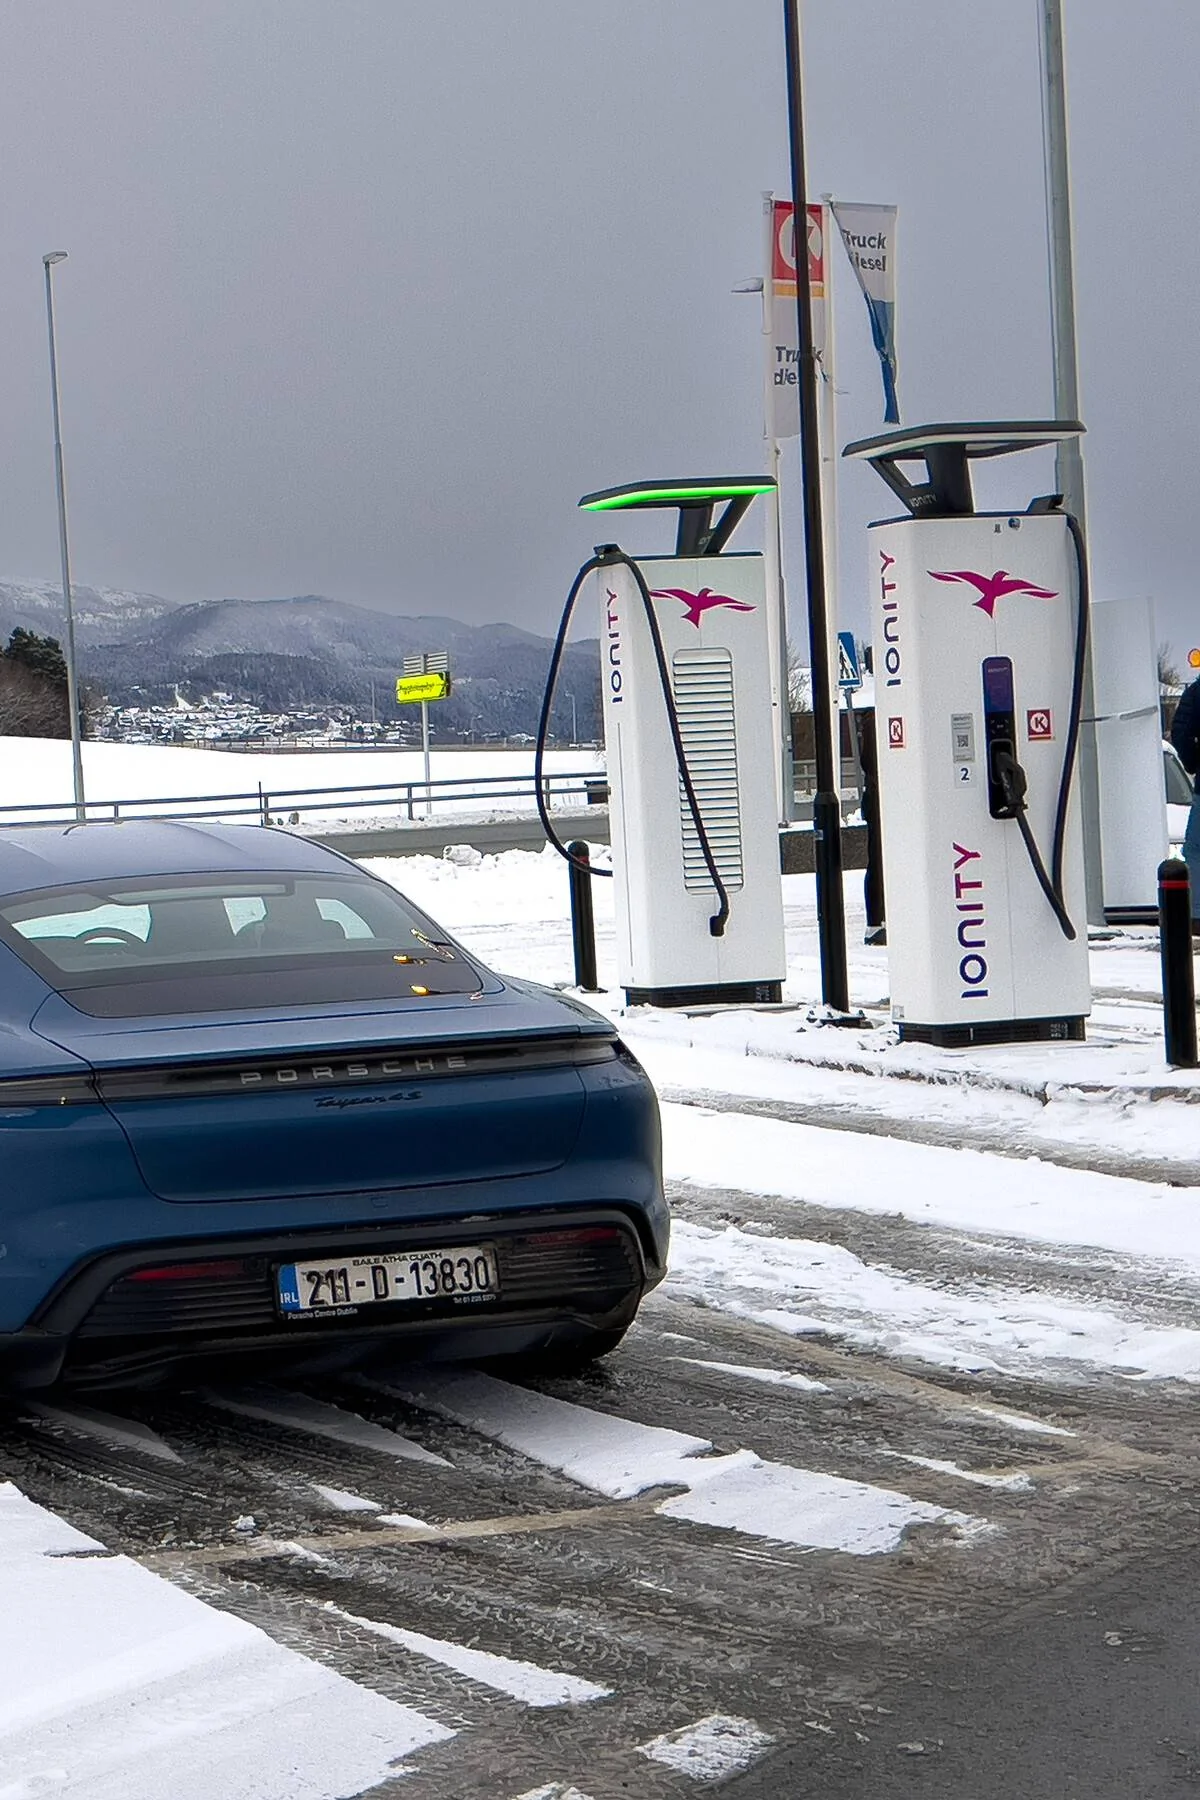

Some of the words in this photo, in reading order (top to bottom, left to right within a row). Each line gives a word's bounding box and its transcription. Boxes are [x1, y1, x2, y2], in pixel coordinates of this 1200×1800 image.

[841, 229, 887, 249] Truck
[850, 251, 886, 271] iesel
[880, 550, 901, 686] IONITY
[606, 588, 623, 703] IONITY
[1033, 715, 1048, 731] K
[960, 767, 970, 781] 2
[952, 842, 989, 998] IONITY
[240, 1056, 467, 1084] PORSCHE
[280, 1292, 299, 1304] IRL
